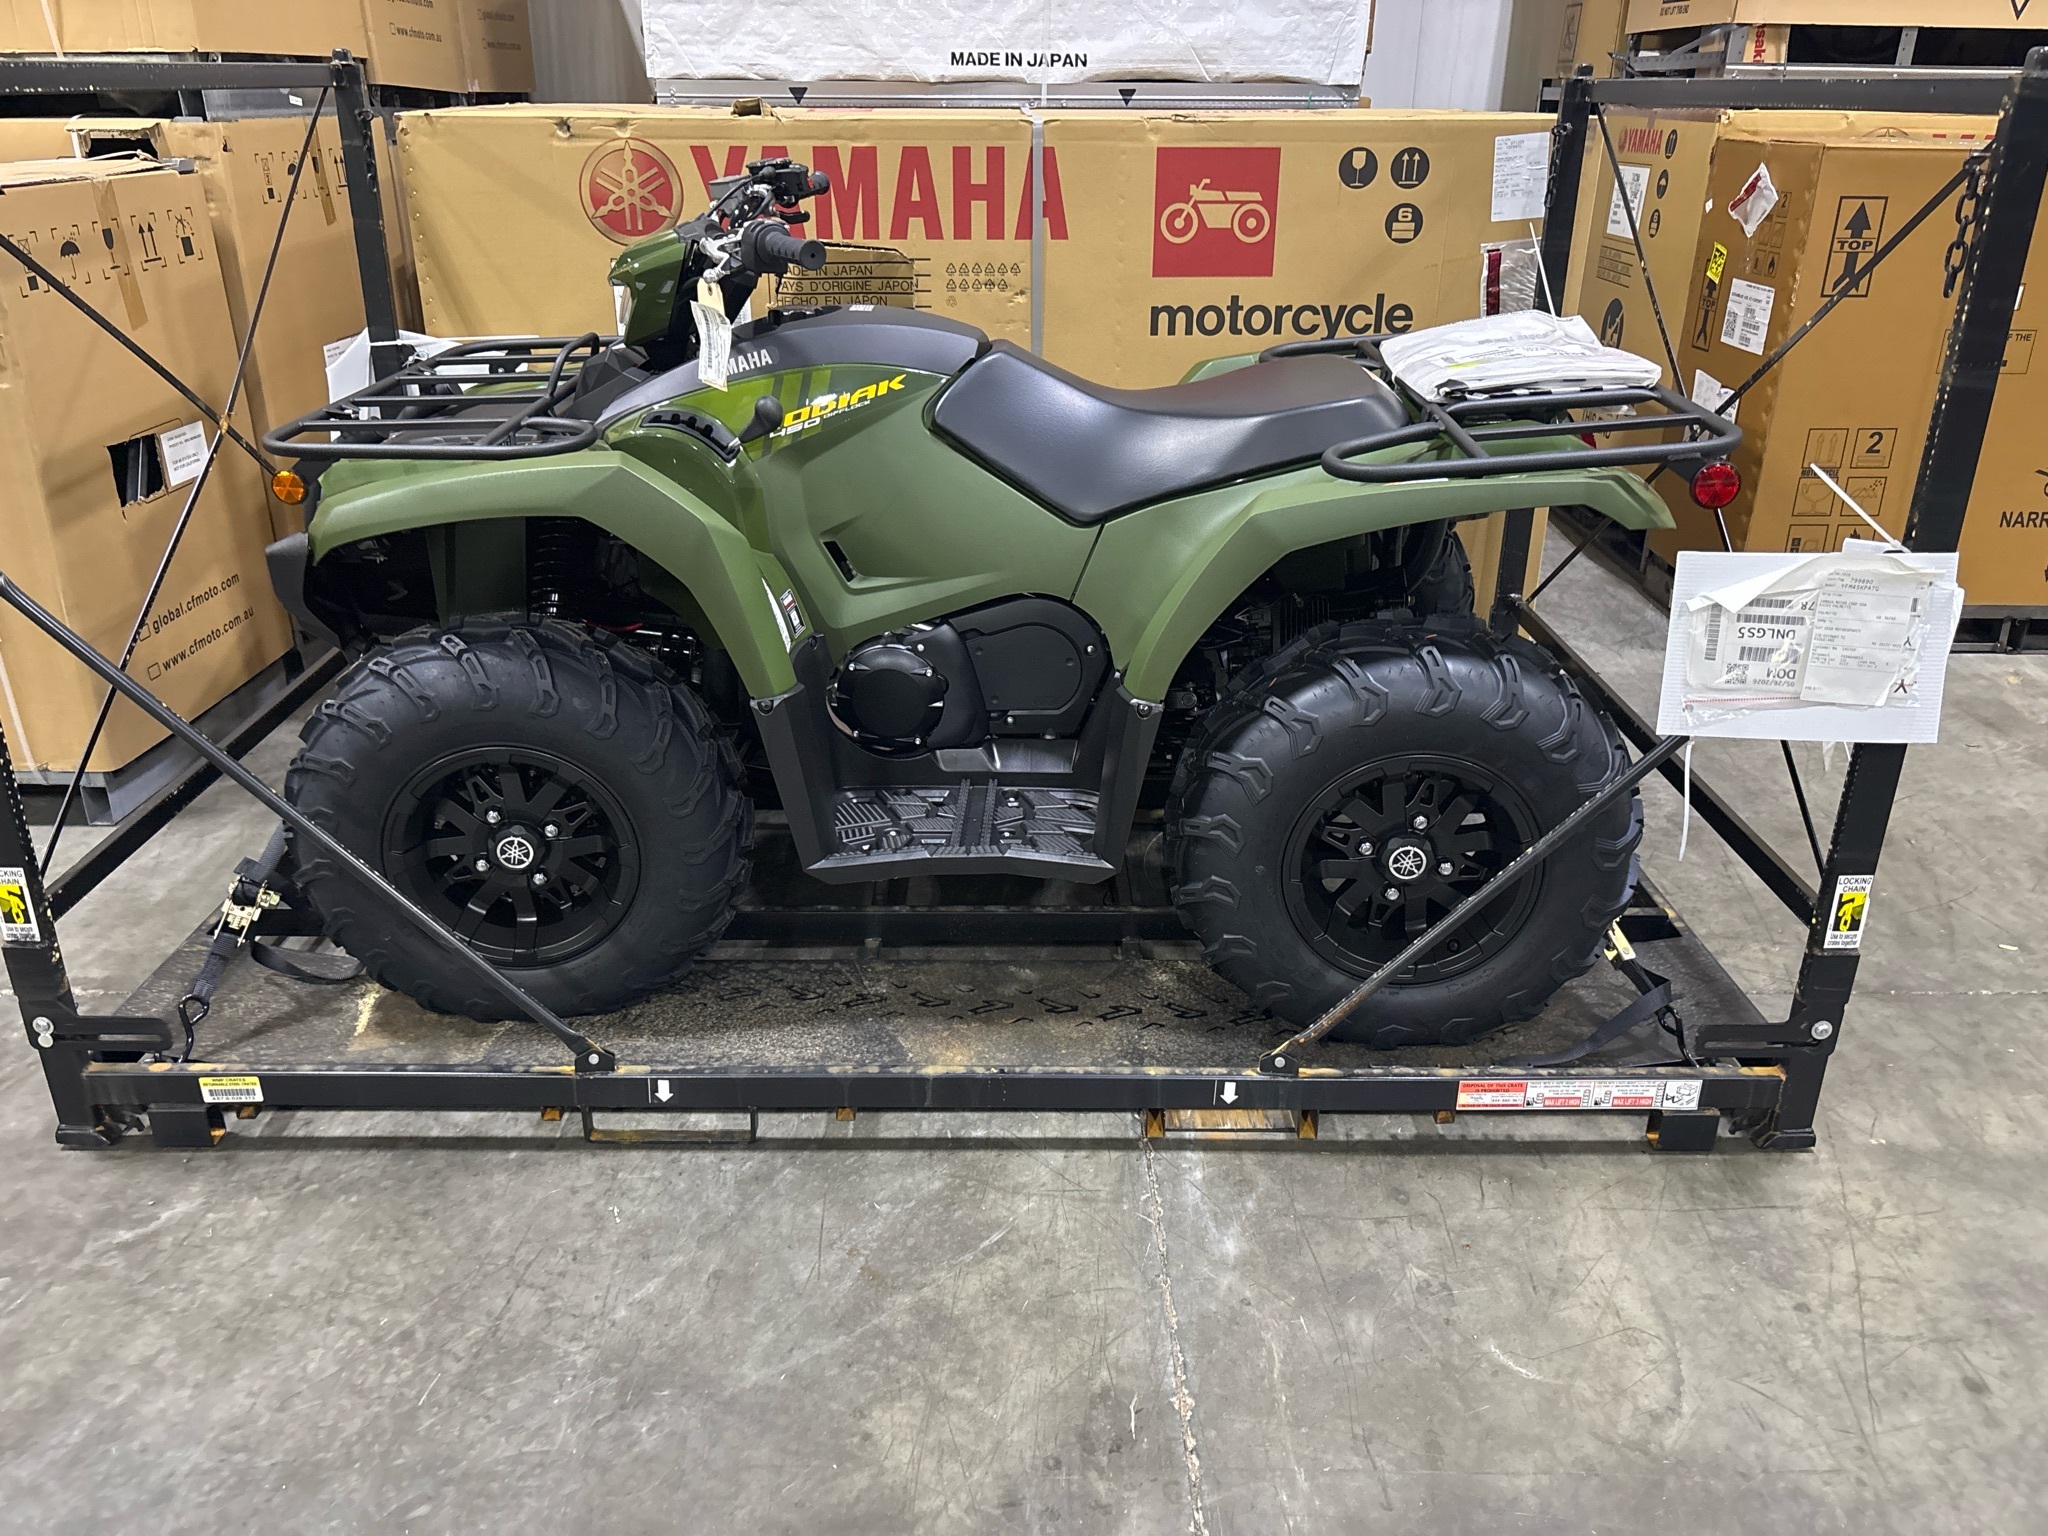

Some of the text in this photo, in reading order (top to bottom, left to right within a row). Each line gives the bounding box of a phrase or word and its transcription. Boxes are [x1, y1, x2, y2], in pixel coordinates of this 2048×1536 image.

[950, 52, 1087, 67] MADE IN JAPAN
[1627, 128, 1663, 155] YAMAHA
[1398, 207, 1412, 222] 6
[1837, 240, 1873, 250] TOP
[787, 265, 810, 277] ADE
[833, 265, 873, 276] JAPAN
[810, 280, 871, 292] D'ORIGINE
[878, 278, 919, 291] JAPON
[825, 296, 841, 306] EN
[847, 295, 888, 306] JAPON
[1702, 296, 1716, 309] TOP
[1149, 293, 1414, 340] motorcycle
[2016, 333, 2033, 341] THE
[727, 349, 773, 376] MAHA
[783, 374, 907, 427] ODIAK
[769, 417, 821, 438] 450
[1865, 431, 1884, 454] 2
[152, 573, 240, 635] global.cfmoto.com
[162, 606, 255, 671] www.cfmoto.com.au
[1839, 877, 1873, 885] LOCKING
[1544, 1098, 1555, 1106] MAX
[1555, 1098, 1564, 1106] LIFT
[1569, 1098, 1579, 1106] HIGH
[1613, 1098, 1624, 1106] MAX
[1625, 1098, 1634, 1106] LIFT
[1640, 1098, 1652, 1106] HIGH
